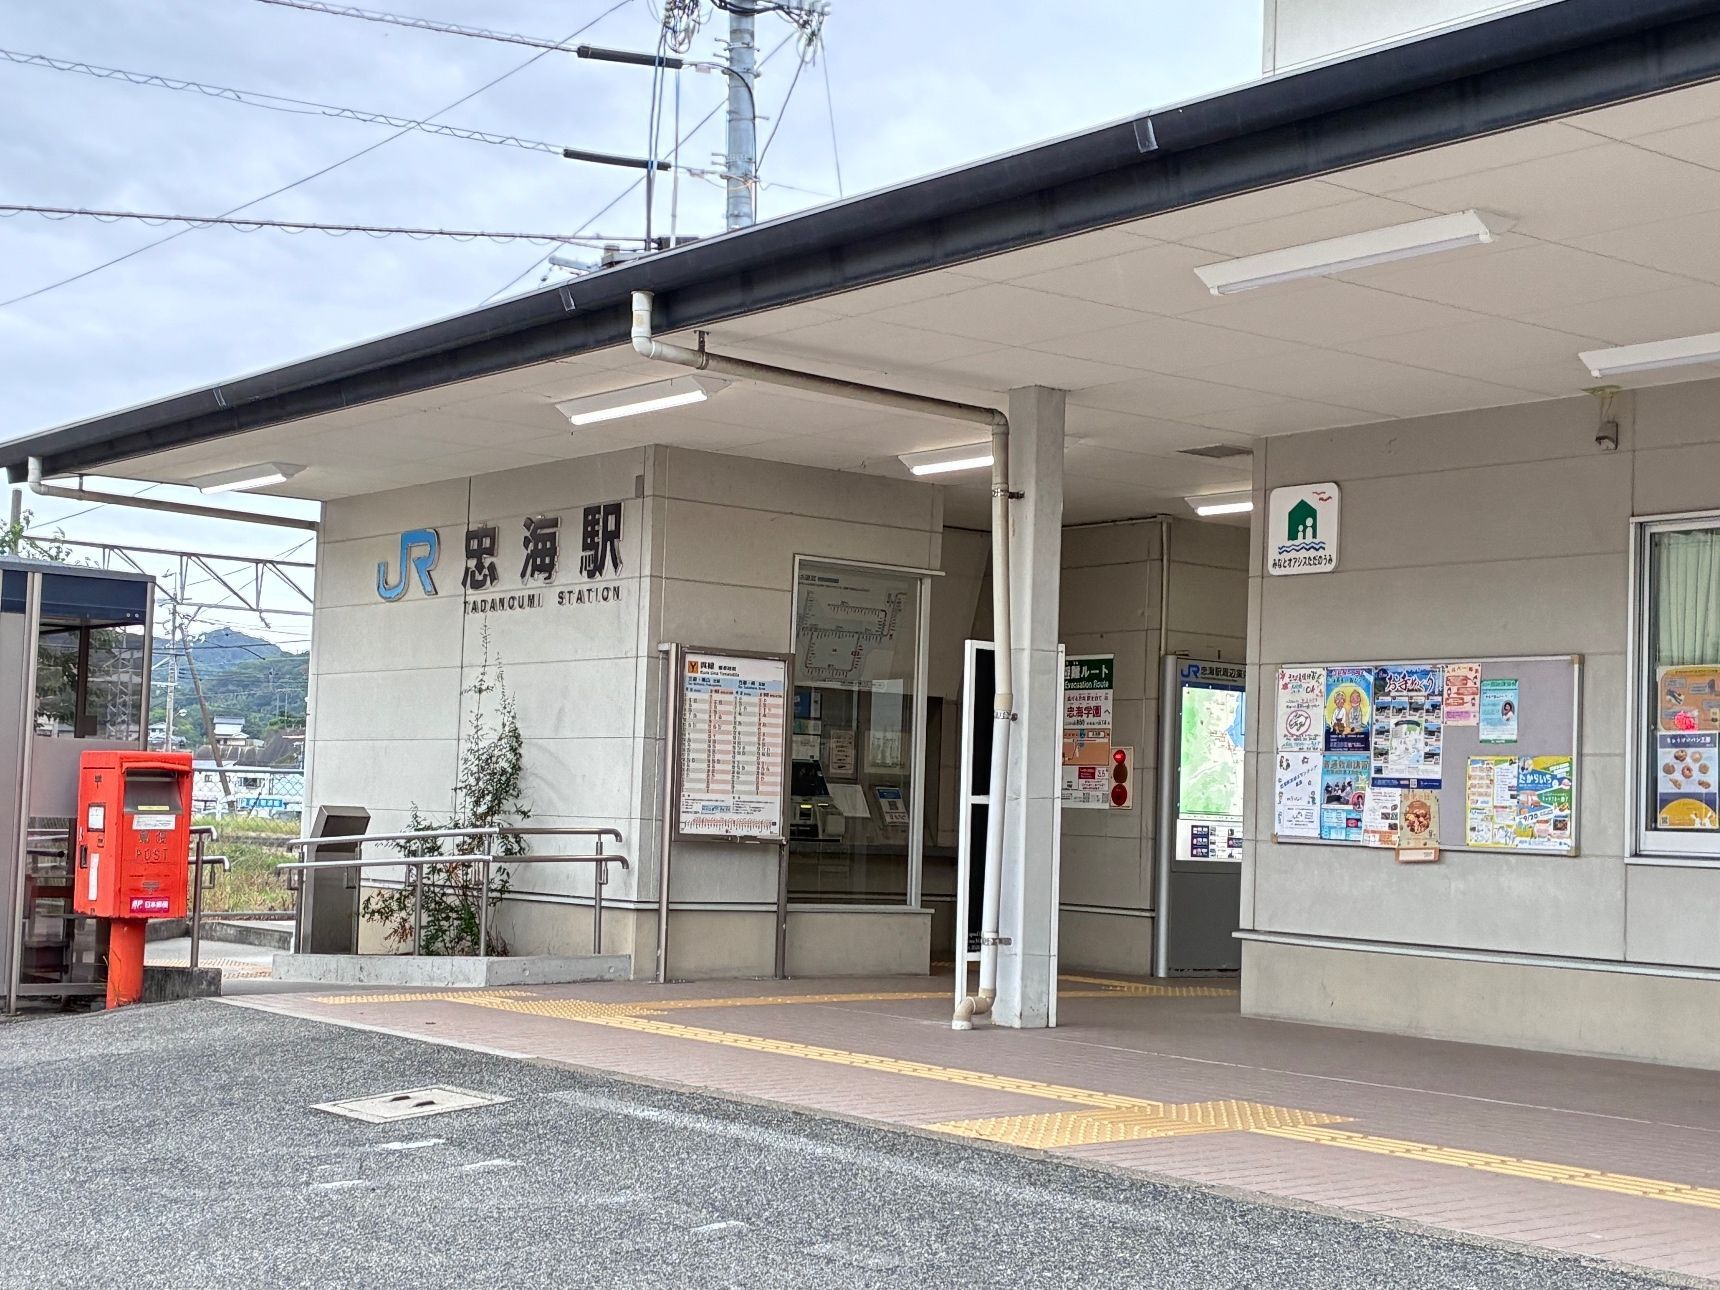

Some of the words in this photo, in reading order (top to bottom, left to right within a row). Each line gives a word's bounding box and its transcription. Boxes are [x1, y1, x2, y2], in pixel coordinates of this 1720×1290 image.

[461, 501, 625, 590] 忠海駅
[376, 528, 440, 602] JR
[1272, 554, 1333, 569] みなとオアシスただのうみ
[463, 592, 543, 615] TADANOUMI
[556, 584, 622, 606] STATION
[1180, 664, 1200, 679] JR
[1201, 666, 1247, 679] 忠海駅周辺案
[1093, 679, 1109, 688] Route
[1066, 705, 1102, 718] 忠海学園
[136, 847, 169, 861] POST
[144, 900, 169, 909] 日本郵便
